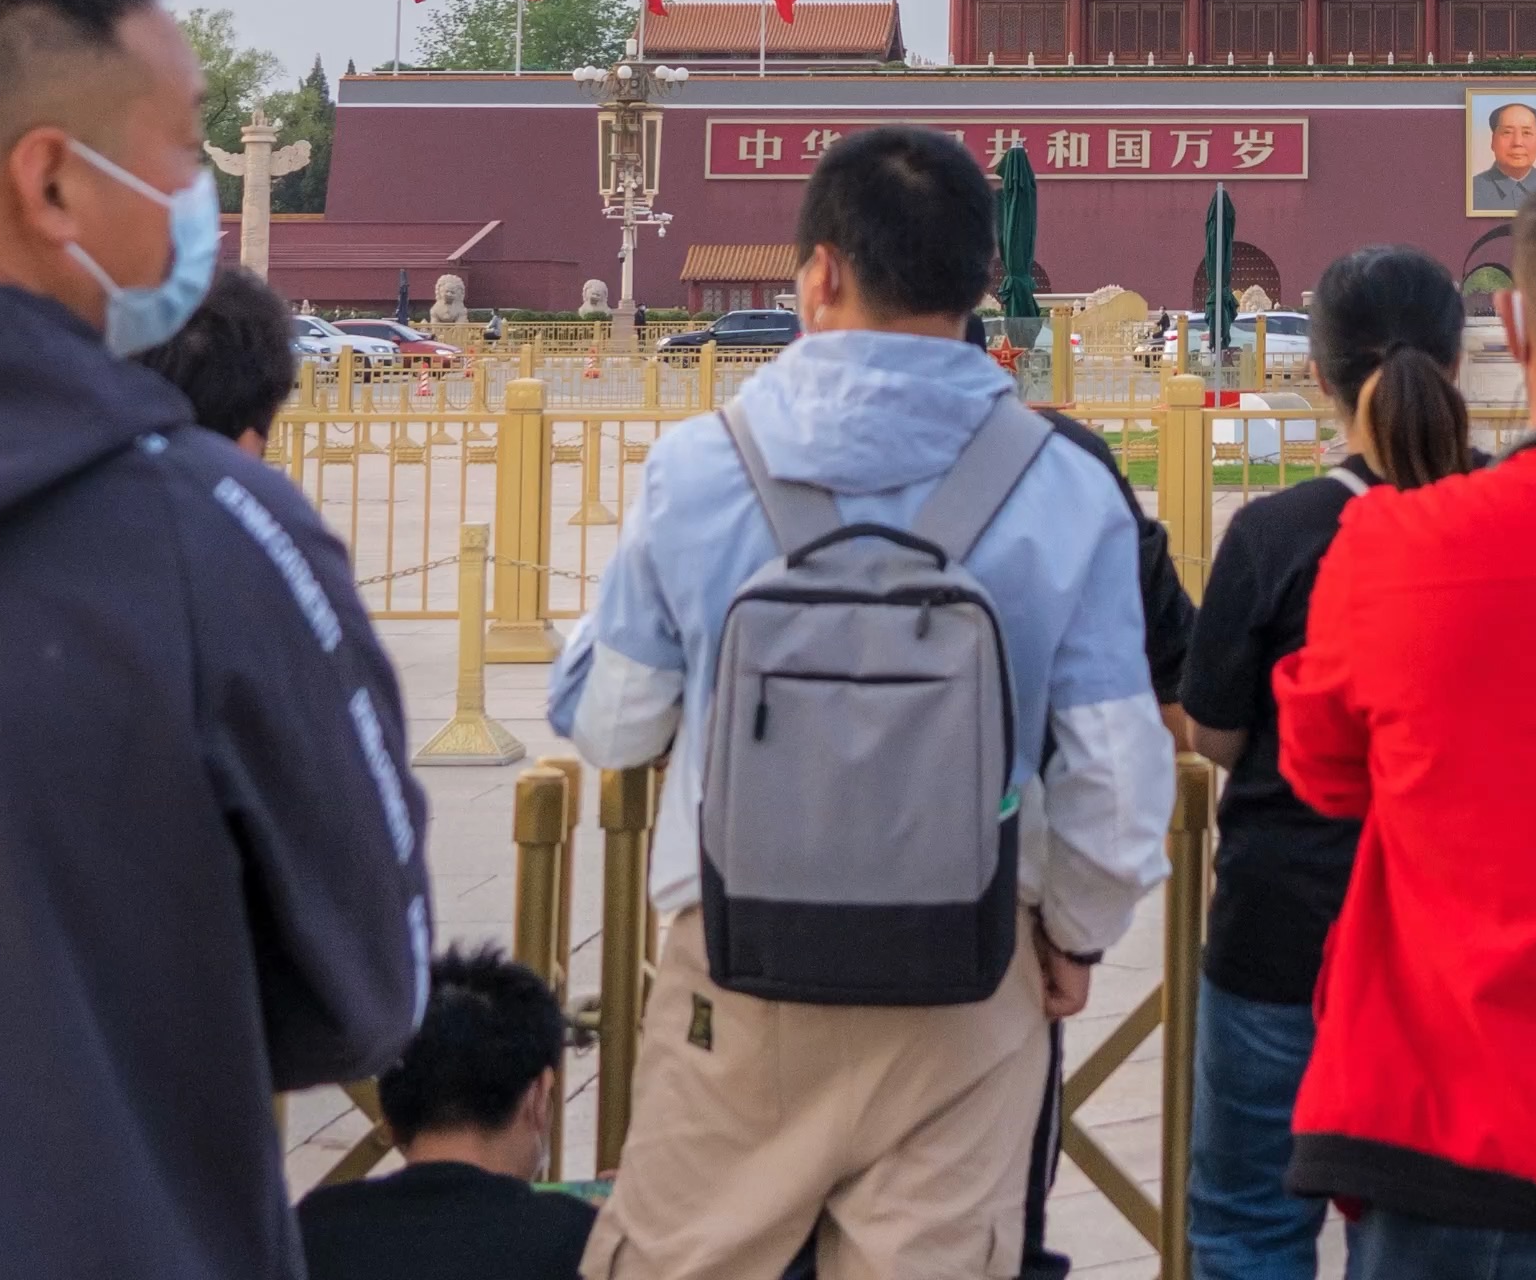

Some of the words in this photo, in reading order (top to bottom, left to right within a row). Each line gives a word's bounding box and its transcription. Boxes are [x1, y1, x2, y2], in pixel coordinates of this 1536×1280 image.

[738, 128, 1275, 169] 中华共和国万岁
